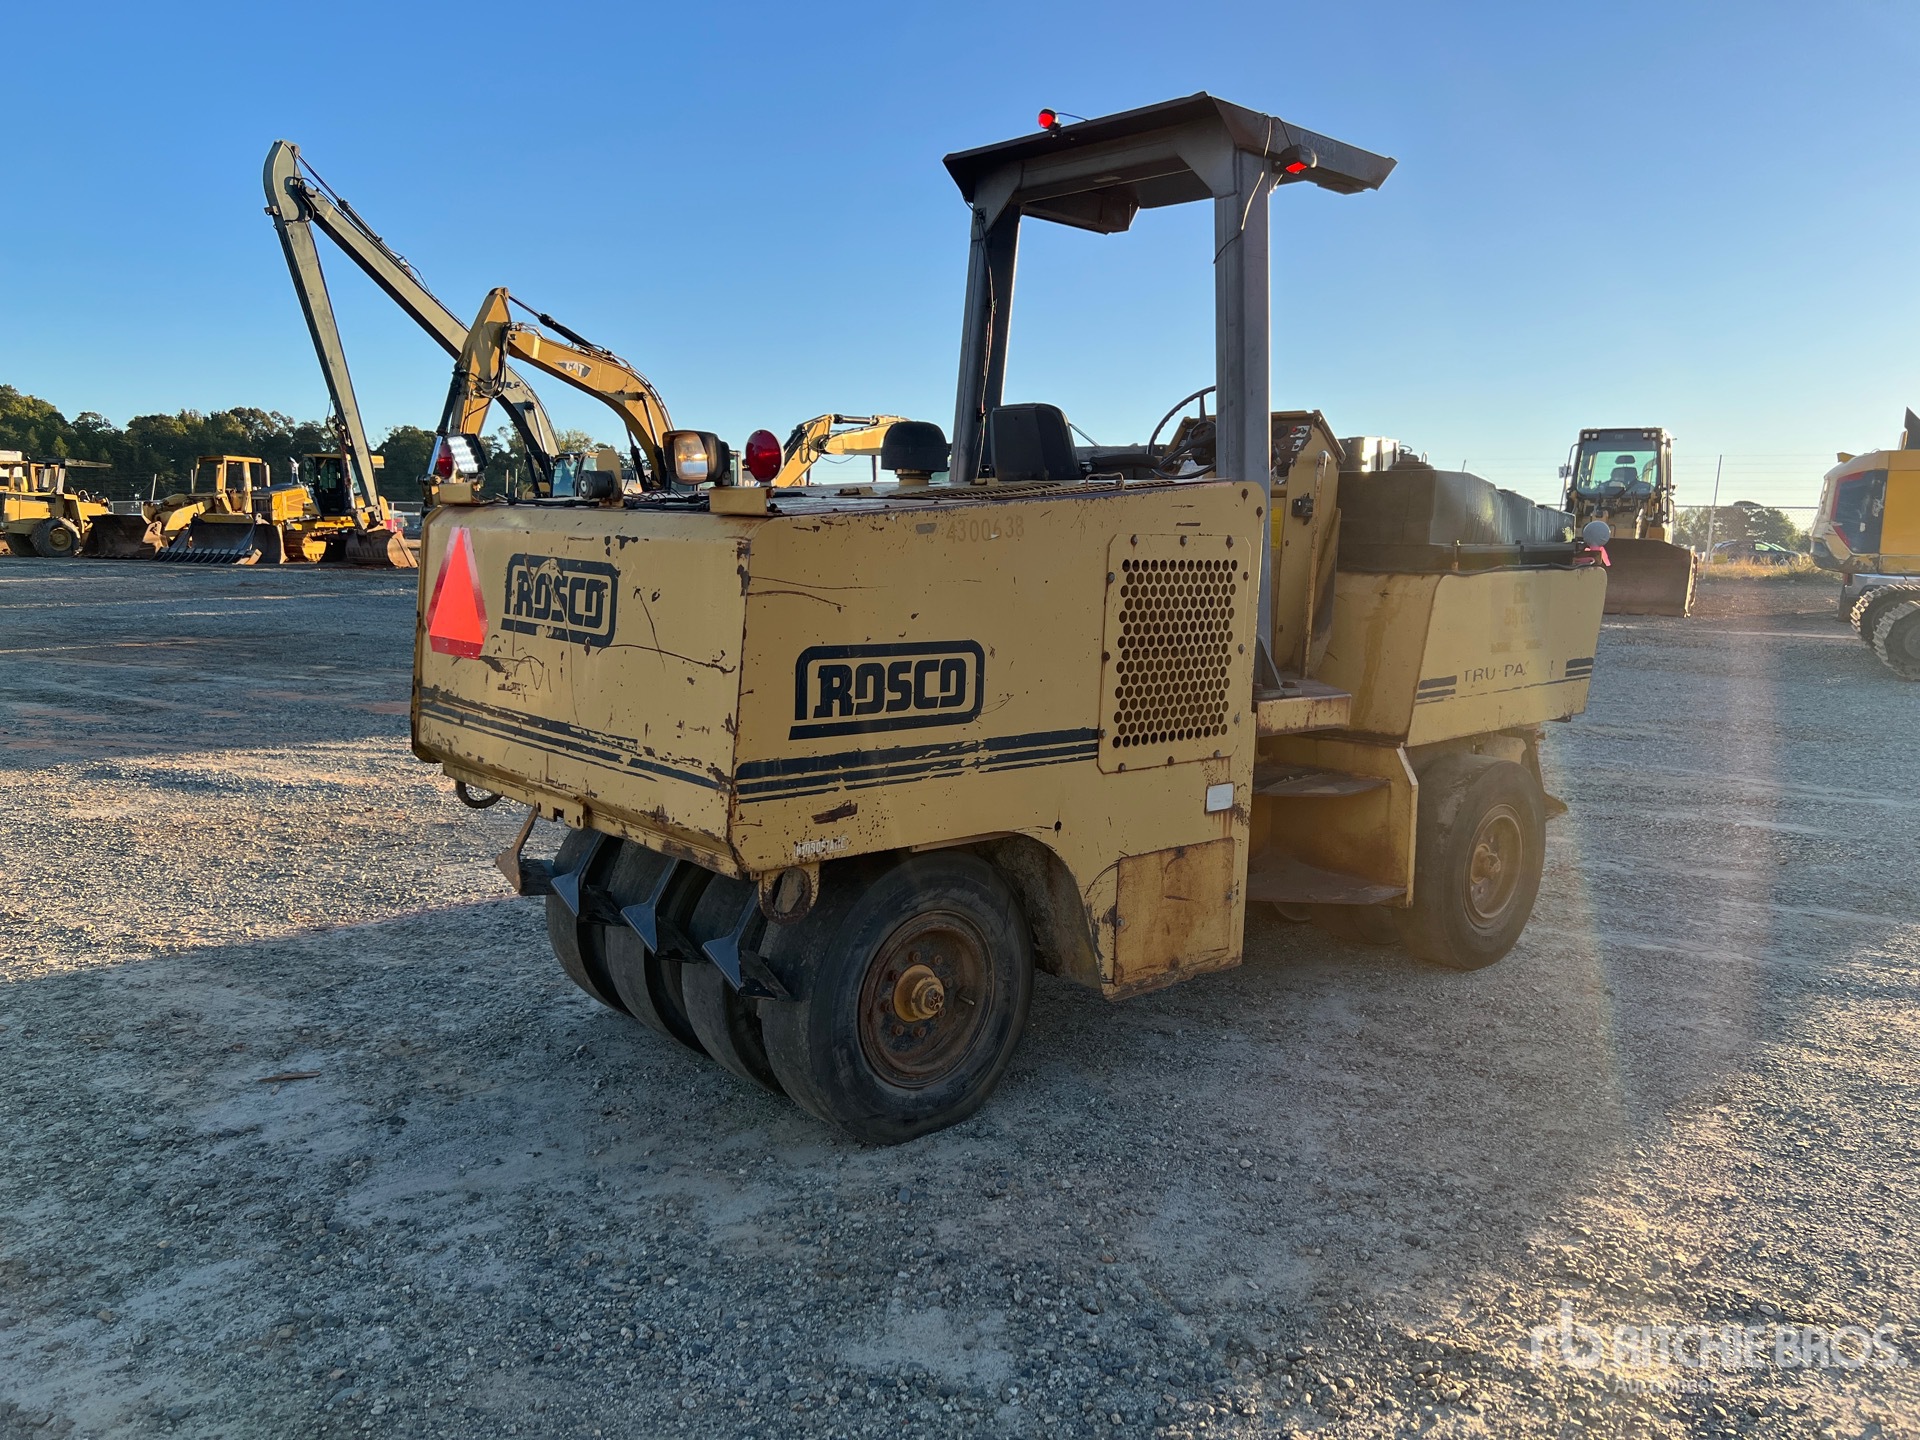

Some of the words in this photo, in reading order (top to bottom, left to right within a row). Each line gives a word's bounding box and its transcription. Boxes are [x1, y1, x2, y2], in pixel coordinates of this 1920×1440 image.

[566, 362, 585, 377] CAT
[946, 515, 1024, 543] 4300638
[513, 571, 608, 629] ROSCO
[813, 658, 966, 718] ROSCO
